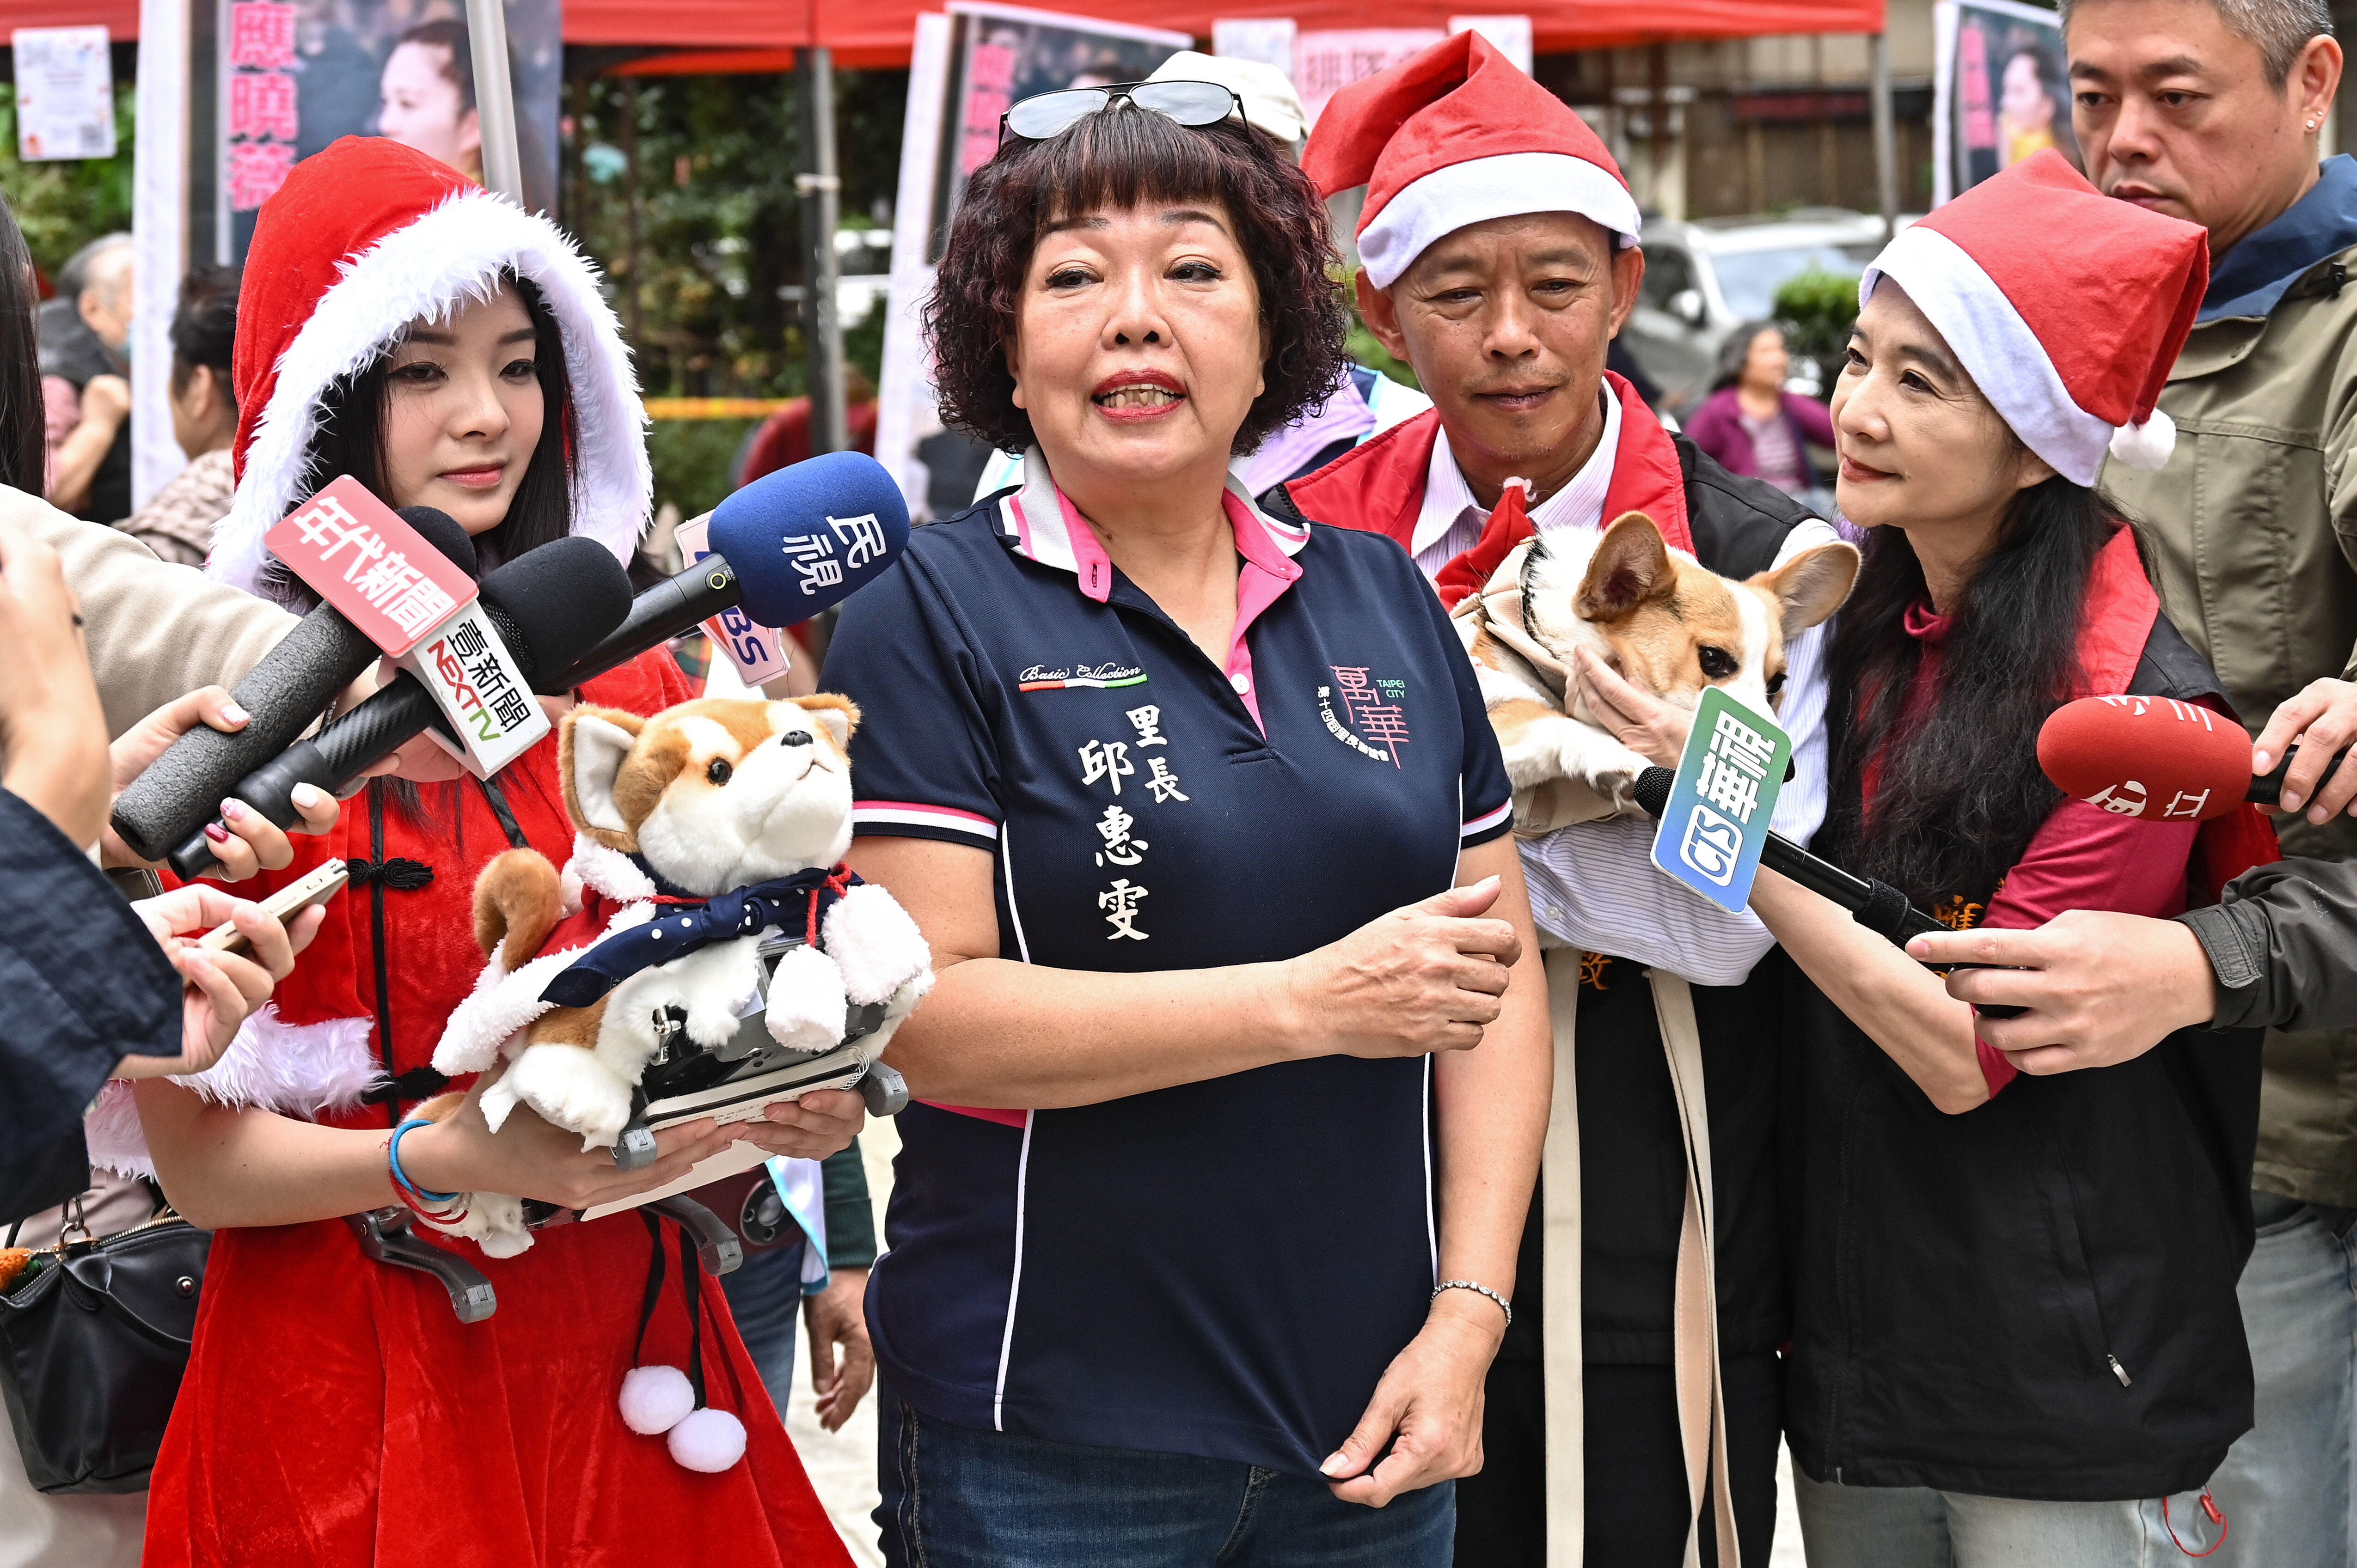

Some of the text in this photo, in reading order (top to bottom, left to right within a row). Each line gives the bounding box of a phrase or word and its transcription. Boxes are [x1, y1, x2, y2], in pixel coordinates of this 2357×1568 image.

[293, 496, 459, 641] 年代新聞
[782, 513, 887, 595] 民視
[447, 618, 531, 733] 壹新聞
[1019, 662, 1141, 682] Basic Collection
[1329, 665, 1410, 769] 萬華
[1376, 679, 1406, 689] TAIPEI
[1385, 689, 1405, 698] CITY
[1126, 704, 1190, 804] 里長
[1696, 709, 1777, 825] 華視
[1077, 739, 1150, 940] 邱惠雯
[1688, 810, 1737, 878] CTS
